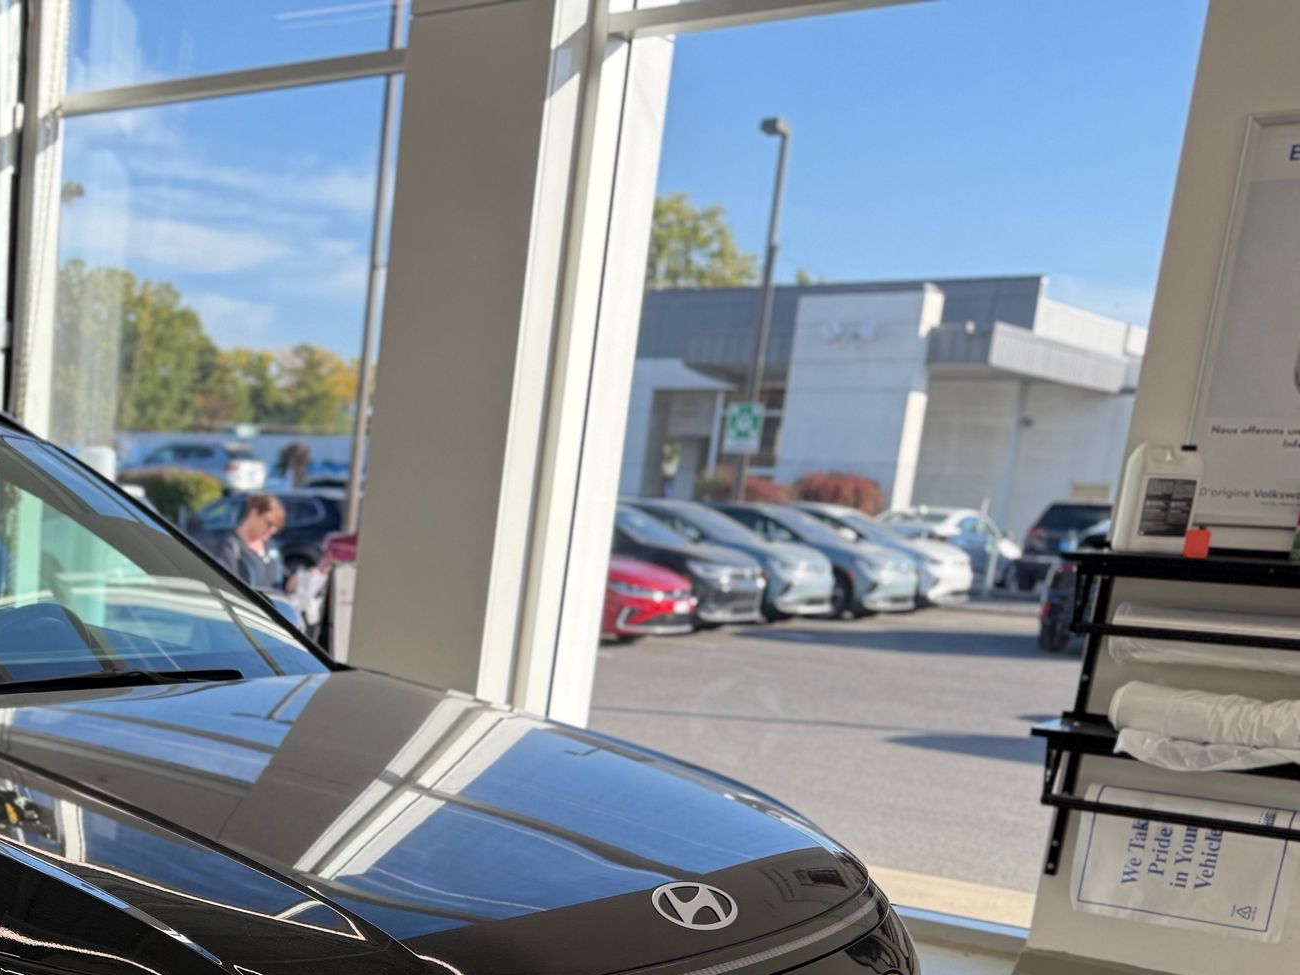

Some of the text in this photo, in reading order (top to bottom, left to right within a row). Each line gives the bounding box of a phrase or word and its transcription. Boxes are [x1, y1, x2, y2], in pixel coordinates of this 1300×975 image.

[1210, 424, 1238, 435] Nous
[1241, 425, 1284, 436] offerons
[1198, 486, 1251, 500] D'origine
[1121, 818, 1150, 885] We Tak
[1147, 825, 1174, 877] Pride
[1169, 871, 1189, 889] in
